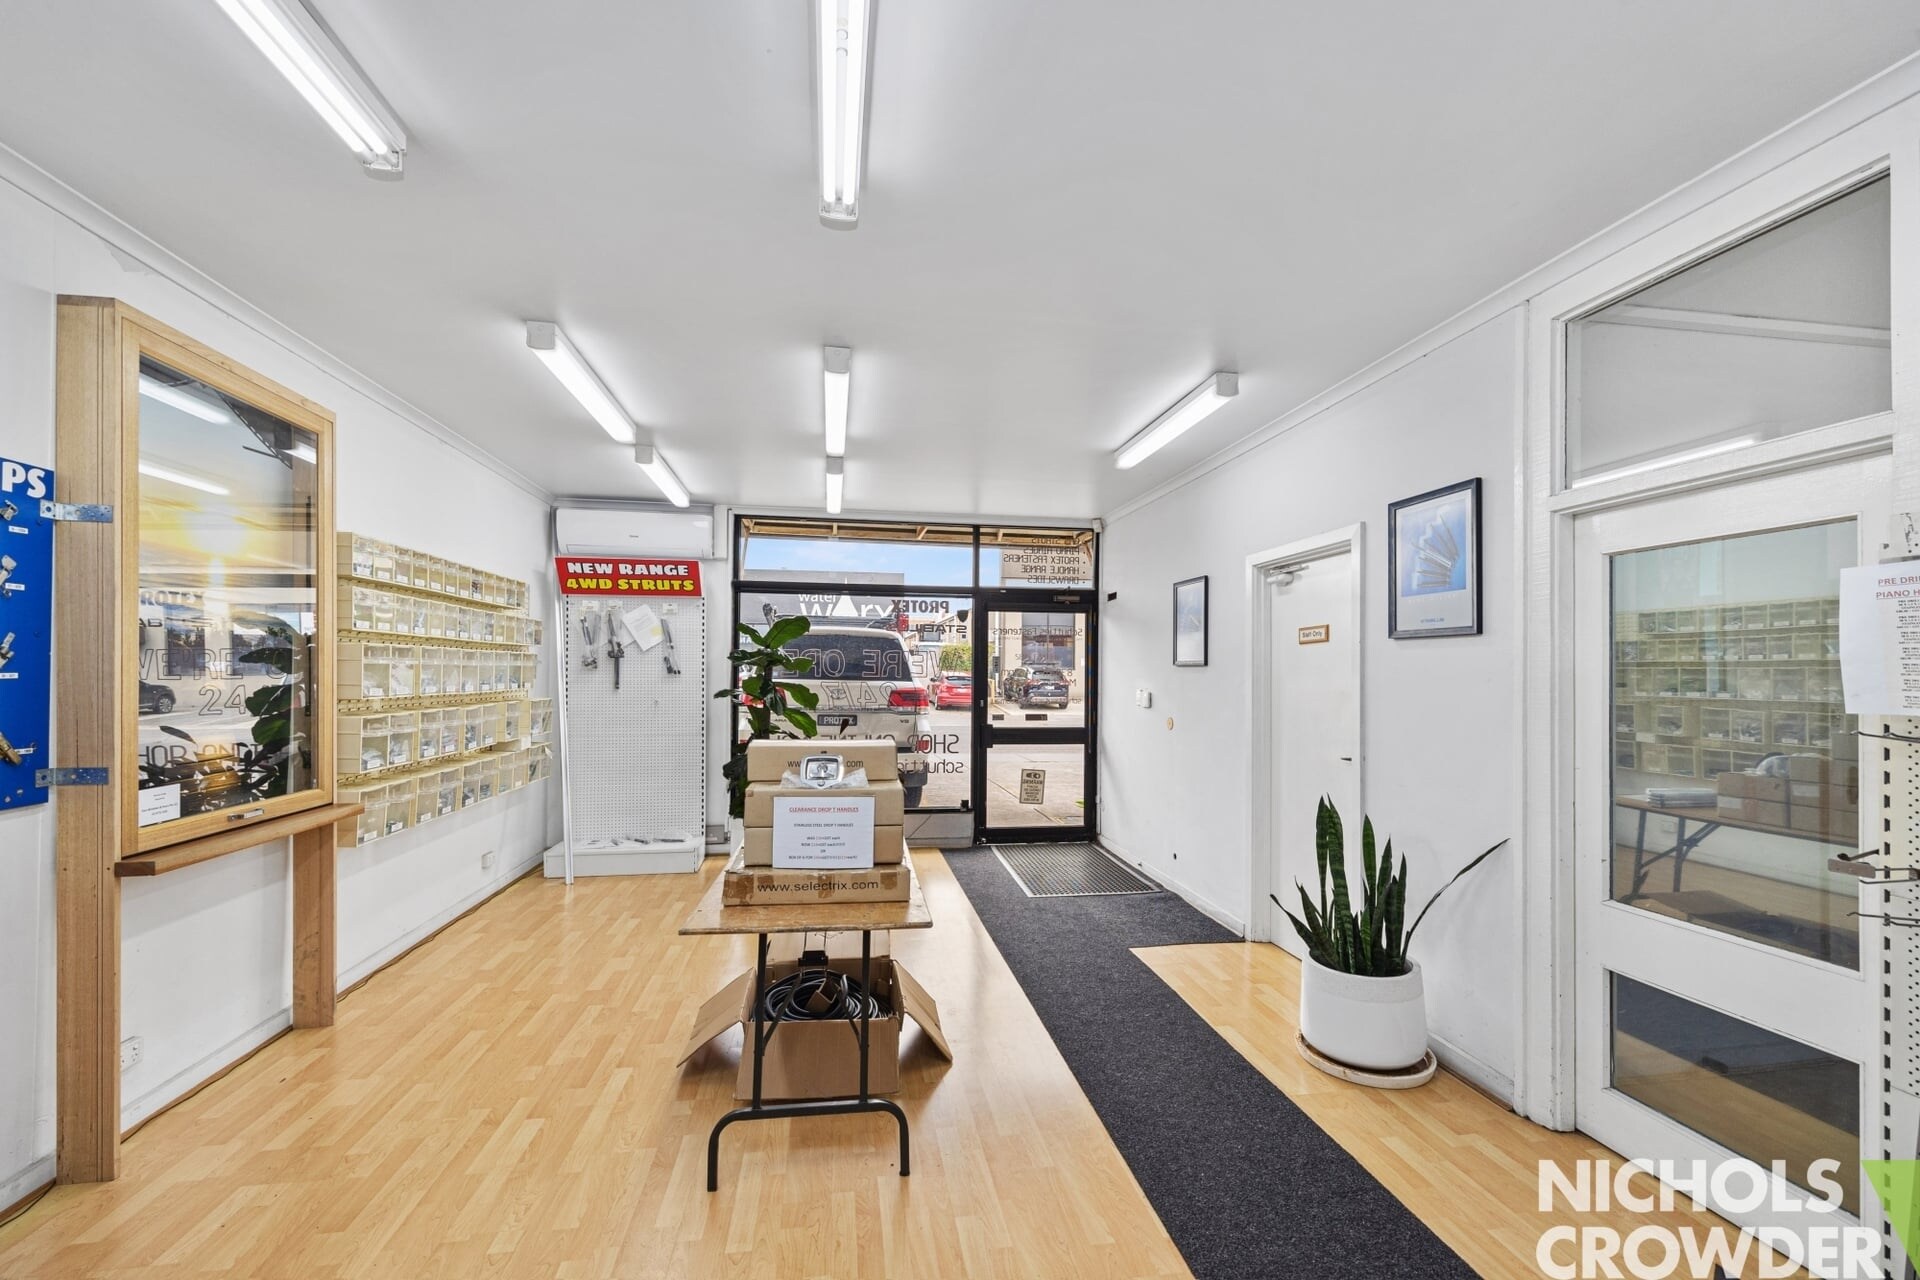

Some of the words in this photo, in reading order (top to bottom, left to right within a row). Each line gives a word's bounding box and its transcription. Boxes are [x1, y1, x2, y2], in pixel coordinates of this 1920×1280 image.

[2, 461, 47, 498] PS
[567, 562, 613, 574] NEW
[618, 563, 689, 576] RANGE
[566, 578, 613, 590] 4WD
[617, 579, 695, 591] STRUTS
[1878, 577, 1897, 586] PRE
[1876, 589, 1911, 599] PIANO
[823, 717, 855, 725] PROTX
[757, 880, 879, 893] www.selectrix.com
